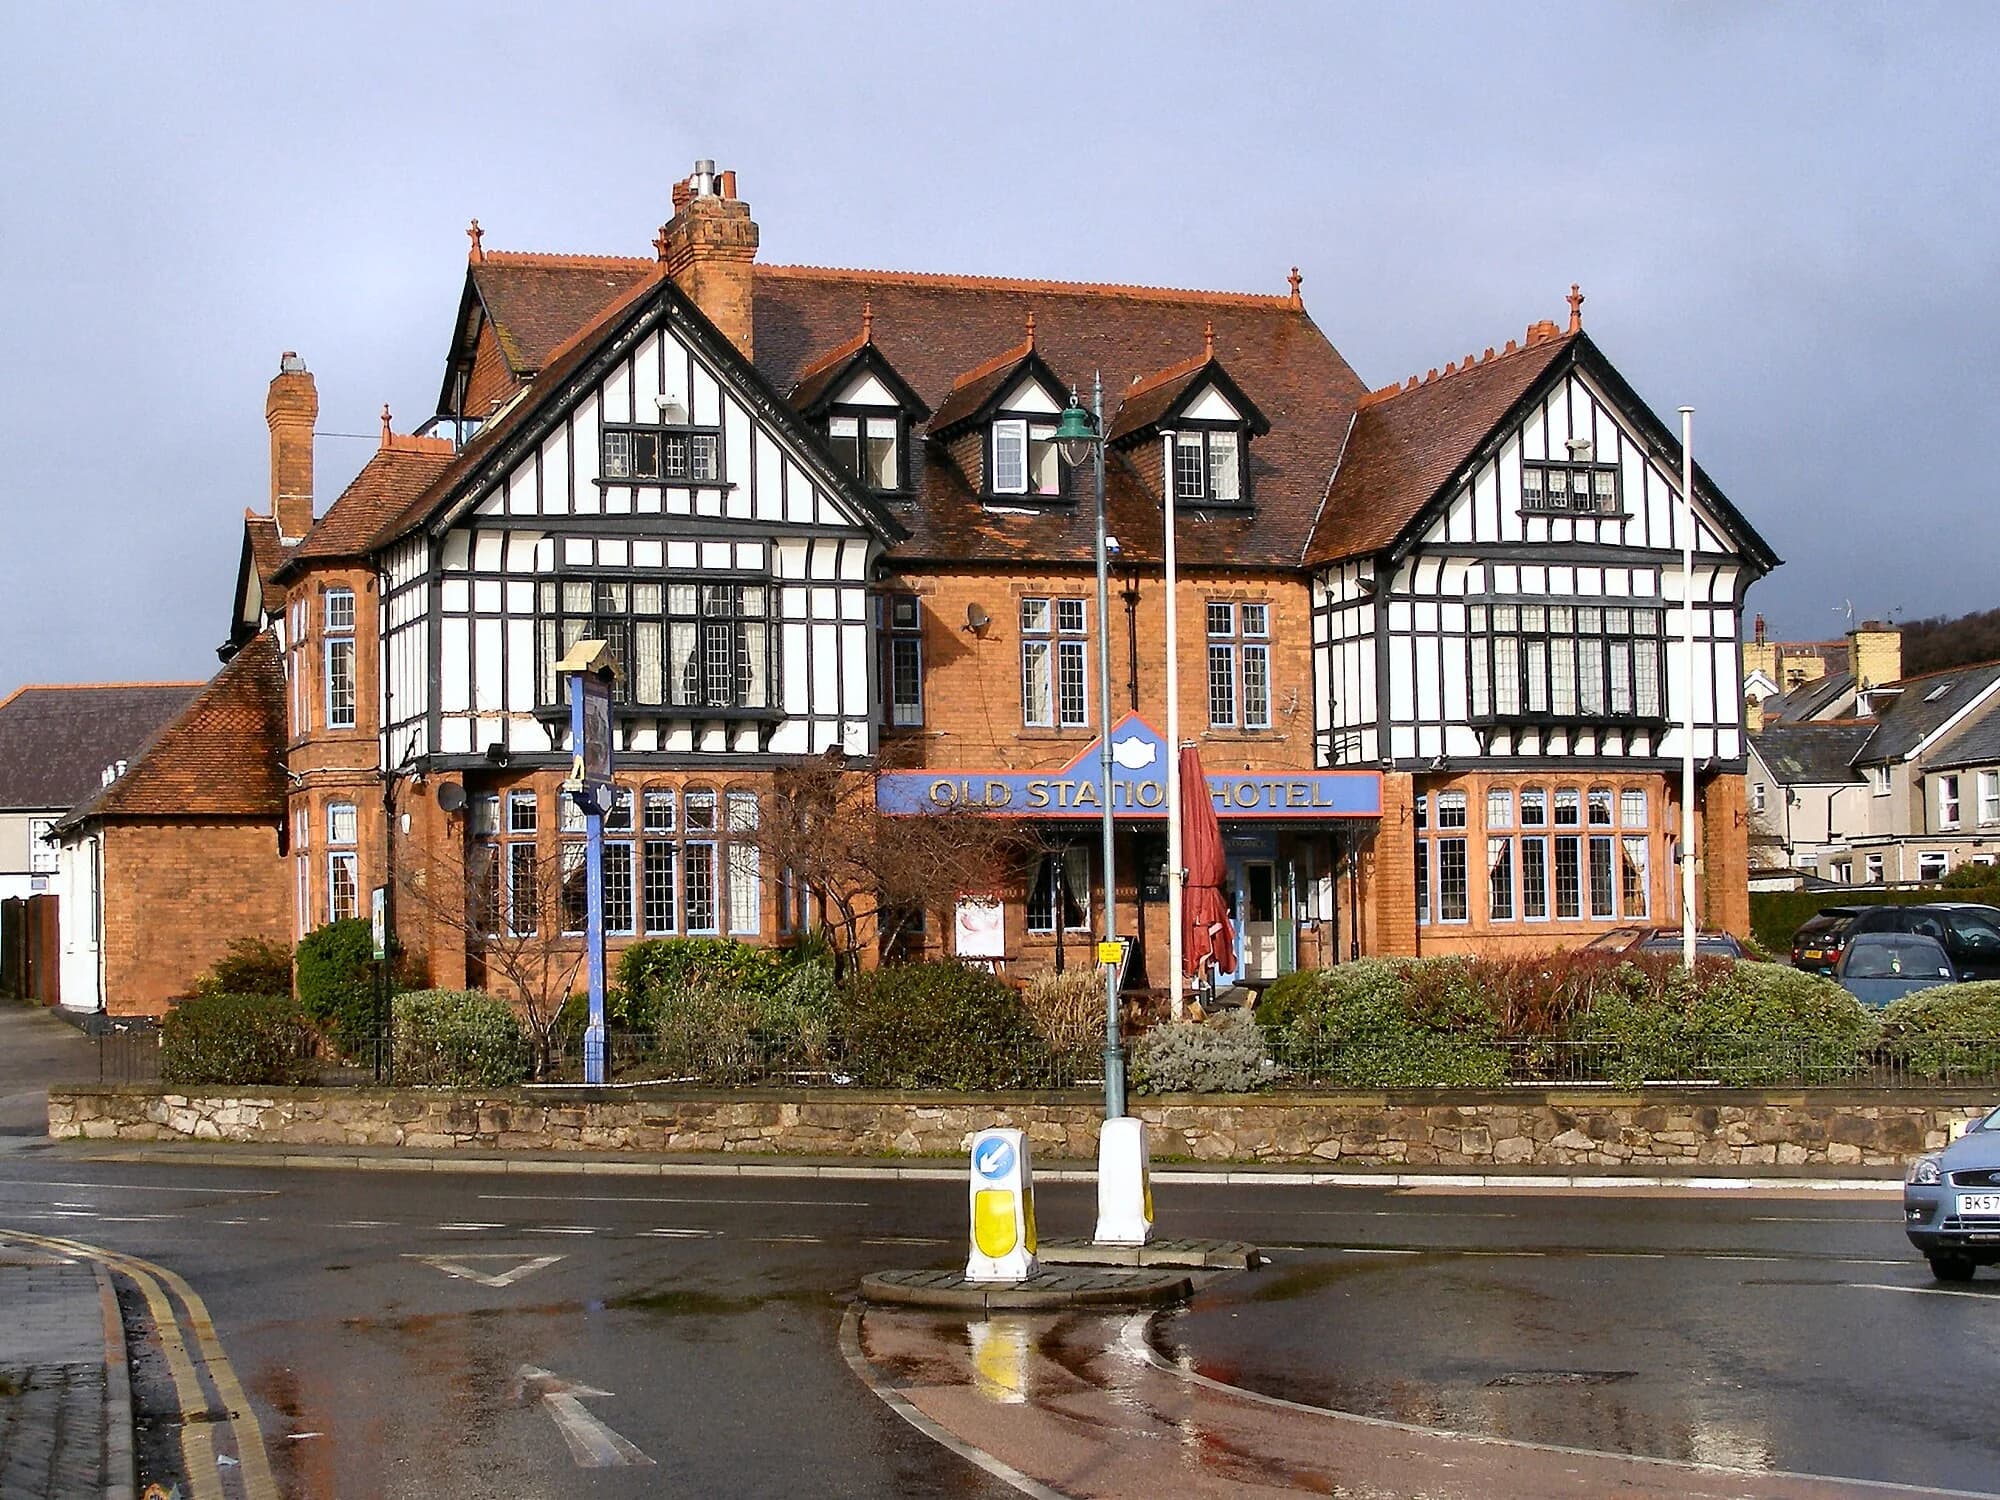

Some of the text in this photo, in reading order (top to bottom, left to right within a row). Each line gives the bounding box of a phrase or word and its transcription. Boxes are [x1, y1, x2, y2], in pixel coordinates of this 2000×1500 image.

[928, 779, 1333, 808] OLD STATIO HOTEL
[1965, 1196, 2000, 1210] BK57
